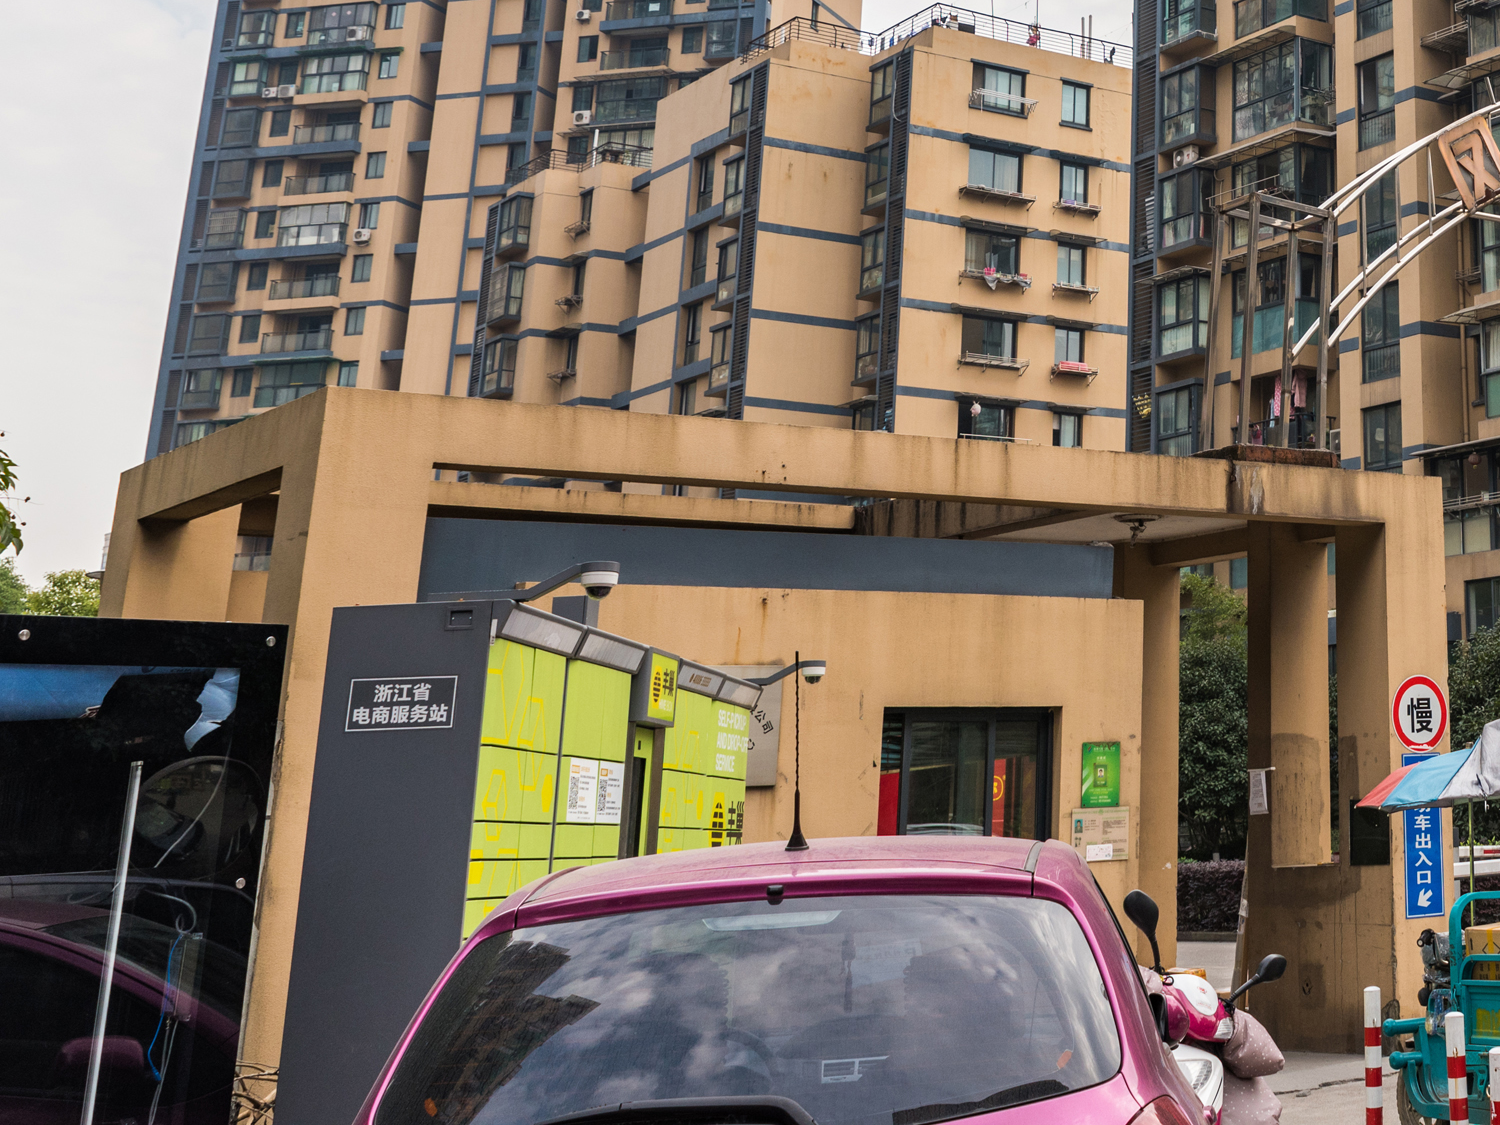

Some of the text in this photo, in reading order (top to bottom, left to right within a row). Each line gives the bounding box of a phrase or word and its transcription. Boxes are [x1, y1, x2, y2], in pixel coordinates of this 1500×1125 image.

[373, 682, 432, 703] 浙江省
[663, 668, 675, 697] 丰巢
[352, 703, 449, 725] 电商服务站
[1407, 697, 1433, 733] 慢
[716, 731, 727, 750] AND
[715, 753, 736, 772] SERVICE
[1414, 807, 1433, 885] 车出入口
